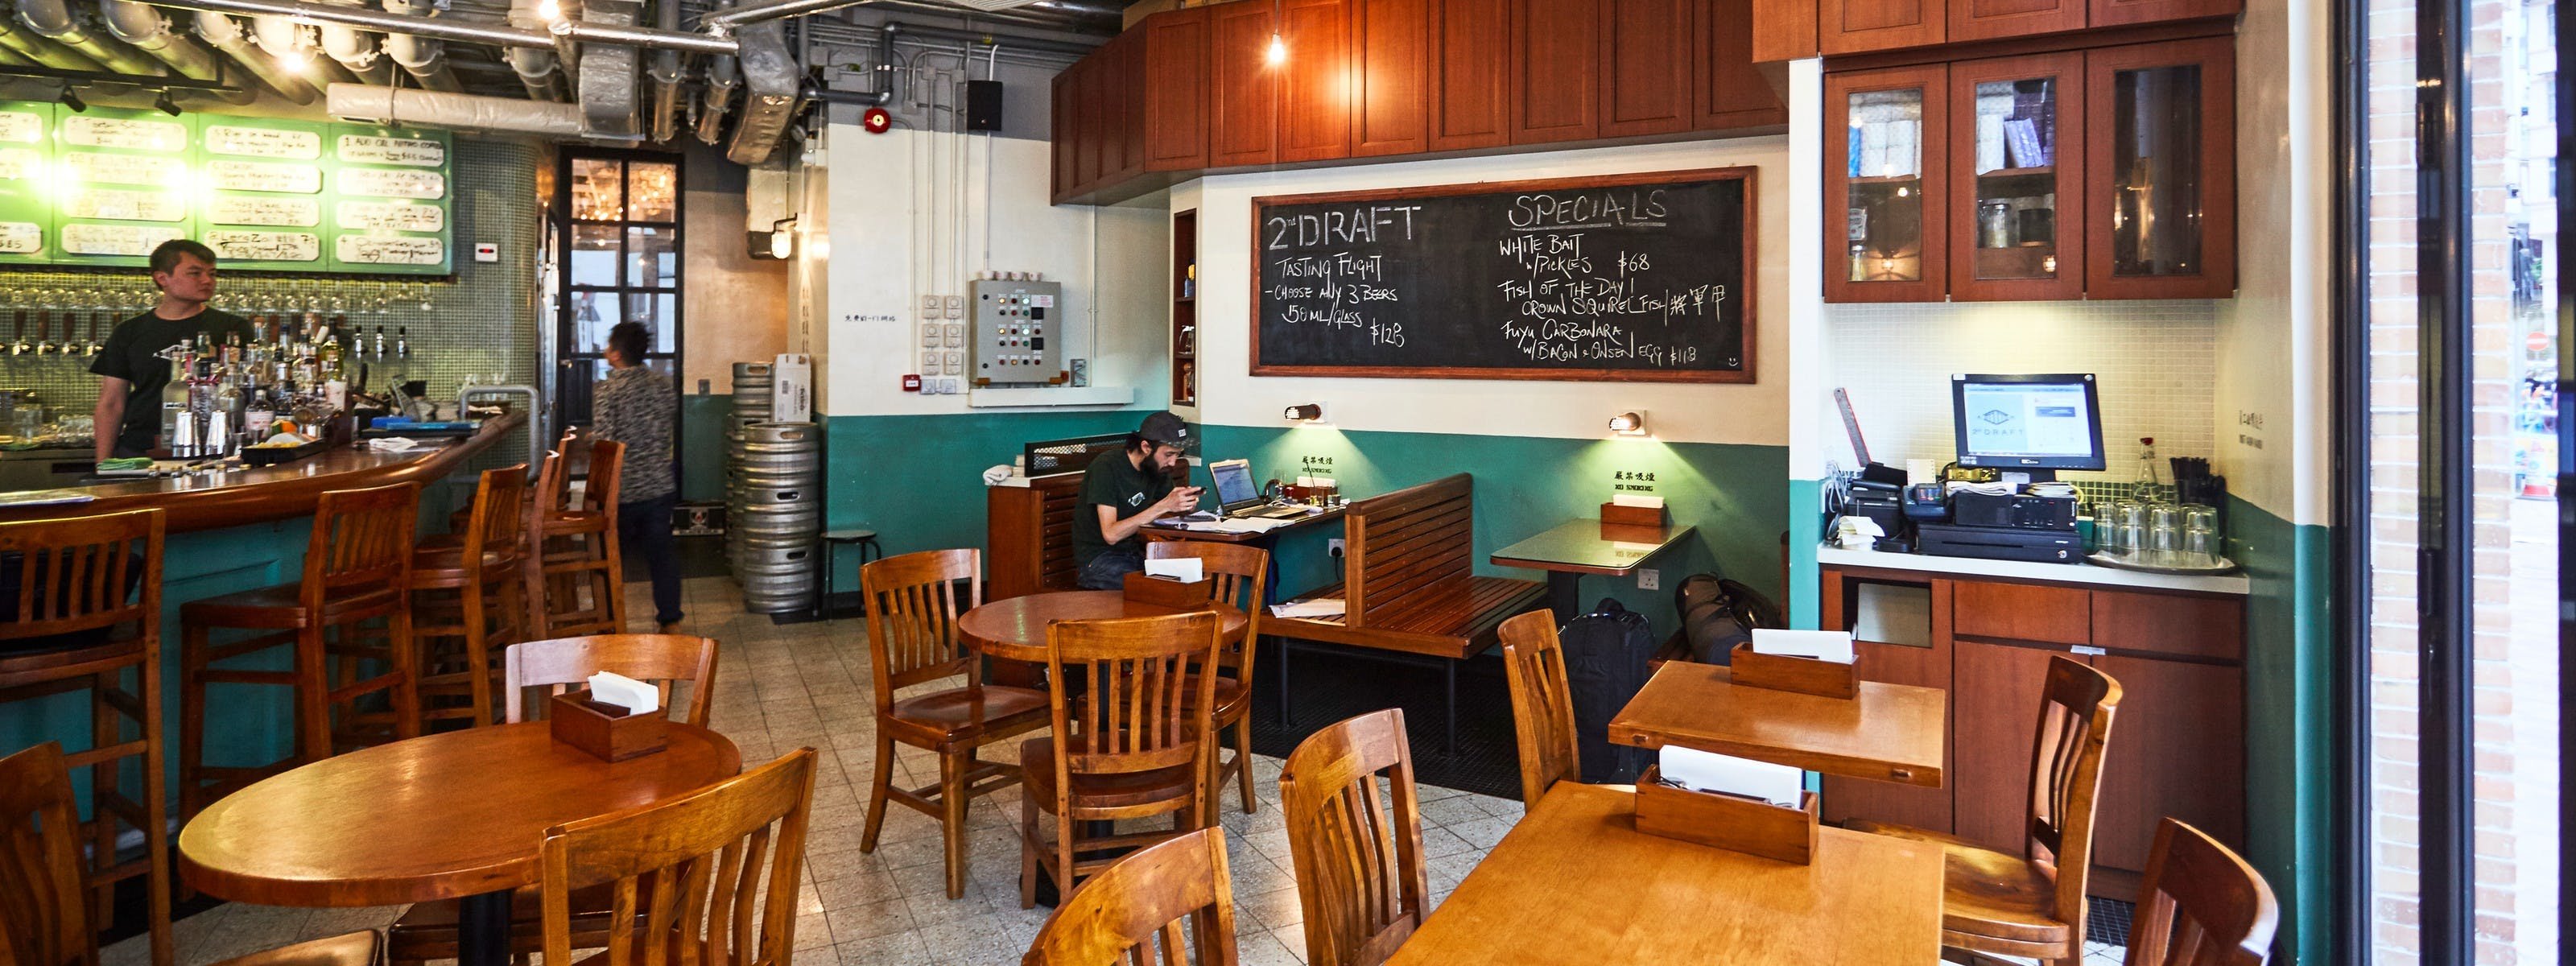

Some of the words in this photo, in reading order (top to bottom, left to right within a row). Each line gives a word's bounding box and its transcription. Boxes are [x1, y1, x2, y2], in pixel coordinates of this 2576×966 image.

[1508, 189, 1666, 227] SPECIALS
[1298, 206, 1422, 246] DRAFT
[1499, 234, 1543, 264] WHITE
[1546, 233, 1584, 259] BAIT
[1275, 257, 1331, 287] TASTING
[1333, 251, 1382, 282] FLIGHT
[1617, 250, 1650, 279] $68
[1319, 282, 1342, 309] ANY
[1347, 283, 1359, 304] 3
[1360, 283, 1398, 302] BEERS
[1497, 279, 1532, 302] FISH
[1539, 278, 1558, 295] OF
[1565, 279, 1593, 299] THE
[1521, 293, 1567, 319] CROWN
[1369, 317, 1406, 348] $128
[1542, 318, 1624, 346] CARBONARA
[1591, 331, 1634, 360] ONSEN
[1639, 344, 1662, 367] EGG
